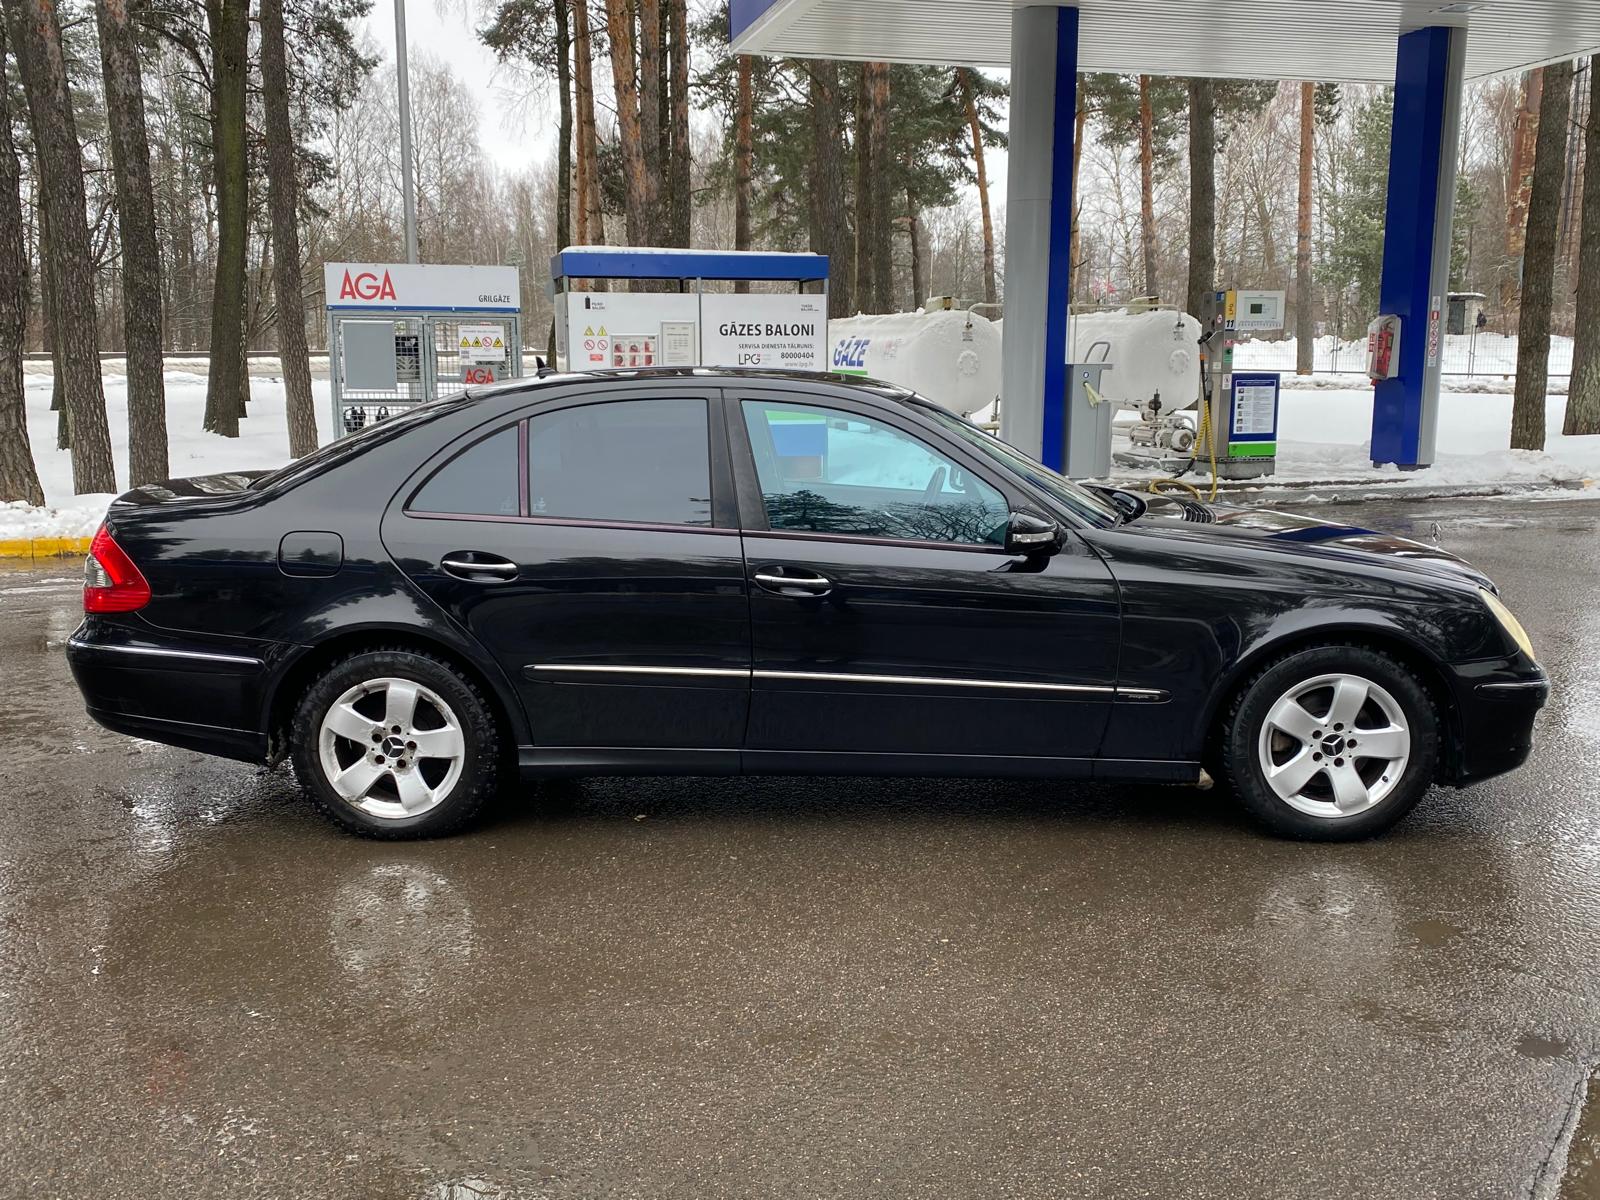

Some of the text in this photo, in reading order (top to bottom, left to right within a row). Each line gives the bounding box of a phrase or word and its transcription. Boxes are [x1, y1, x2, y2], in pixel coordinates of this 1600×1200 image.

[339, 267, 397, 300] AGA
[478, 294, 511, 303] GRILGĀZE
[719, 321, 814, 336] GĀZES BALONI
[1226, 319, 1235, 328] 11
[738, 353, 761, 366] LPG
[465, 367, 495, 385] AGA
